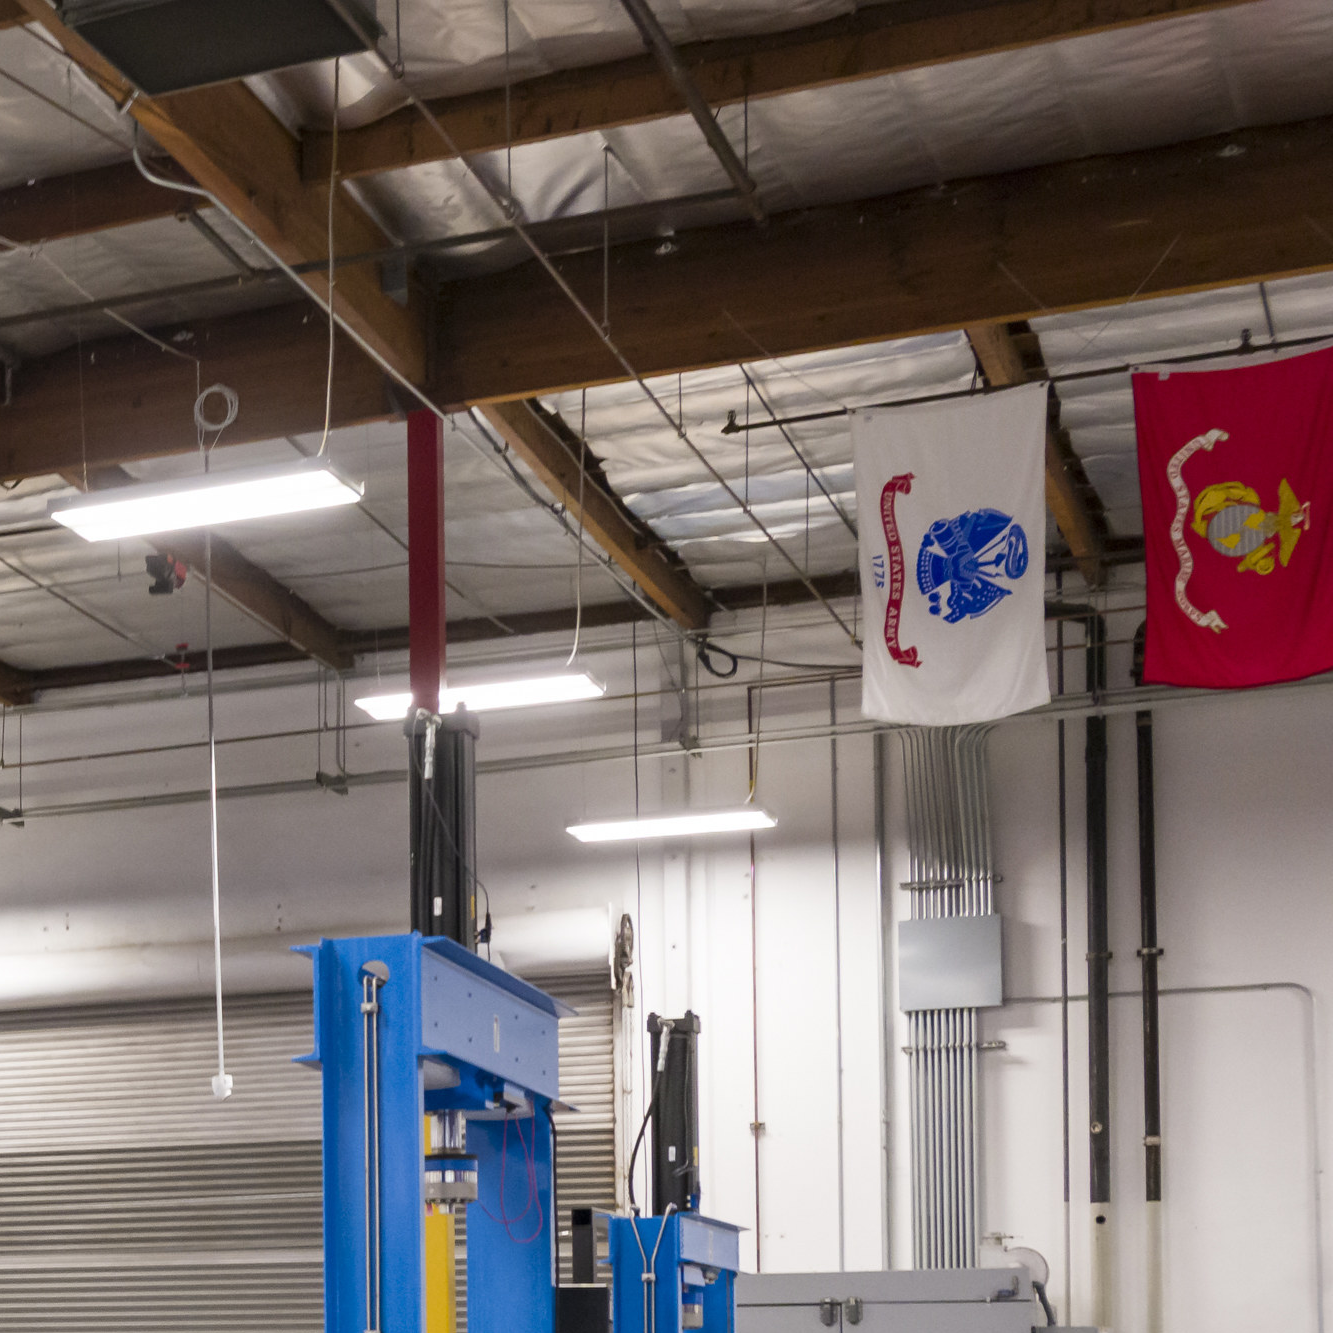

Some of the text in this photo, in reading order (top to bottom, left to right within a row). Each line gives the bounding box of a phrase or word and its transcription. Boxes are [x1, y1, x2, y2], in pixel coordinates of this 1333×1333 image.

[872, 555, 886, 589] 1775
[883, 491, 902, 649] UNITED STATES ARMY
